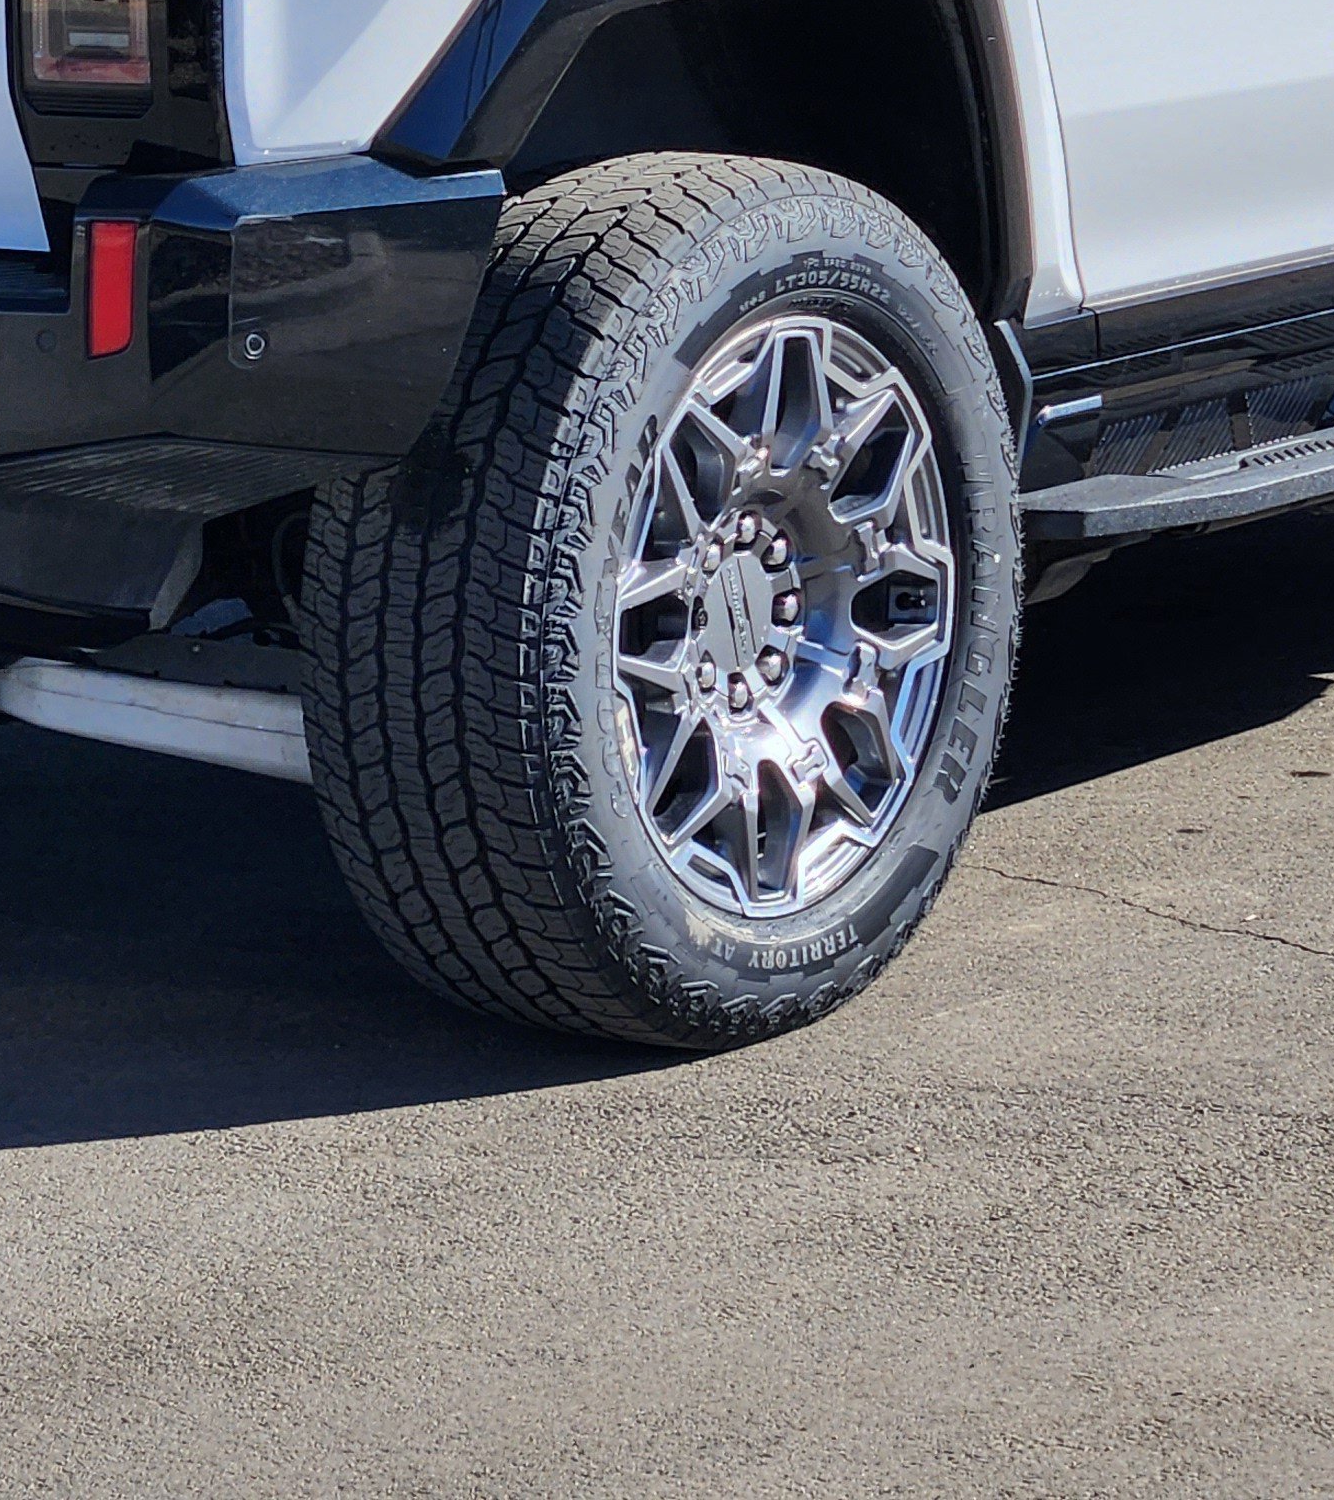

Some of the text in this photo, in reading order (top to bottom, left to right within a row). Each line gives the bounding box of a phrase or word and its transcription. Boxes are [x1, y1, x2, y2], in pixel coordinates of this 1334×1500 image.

[775, 270, 892, 305] LT305/55R22
[710, 922, 860, 970] TERRITORY AT
